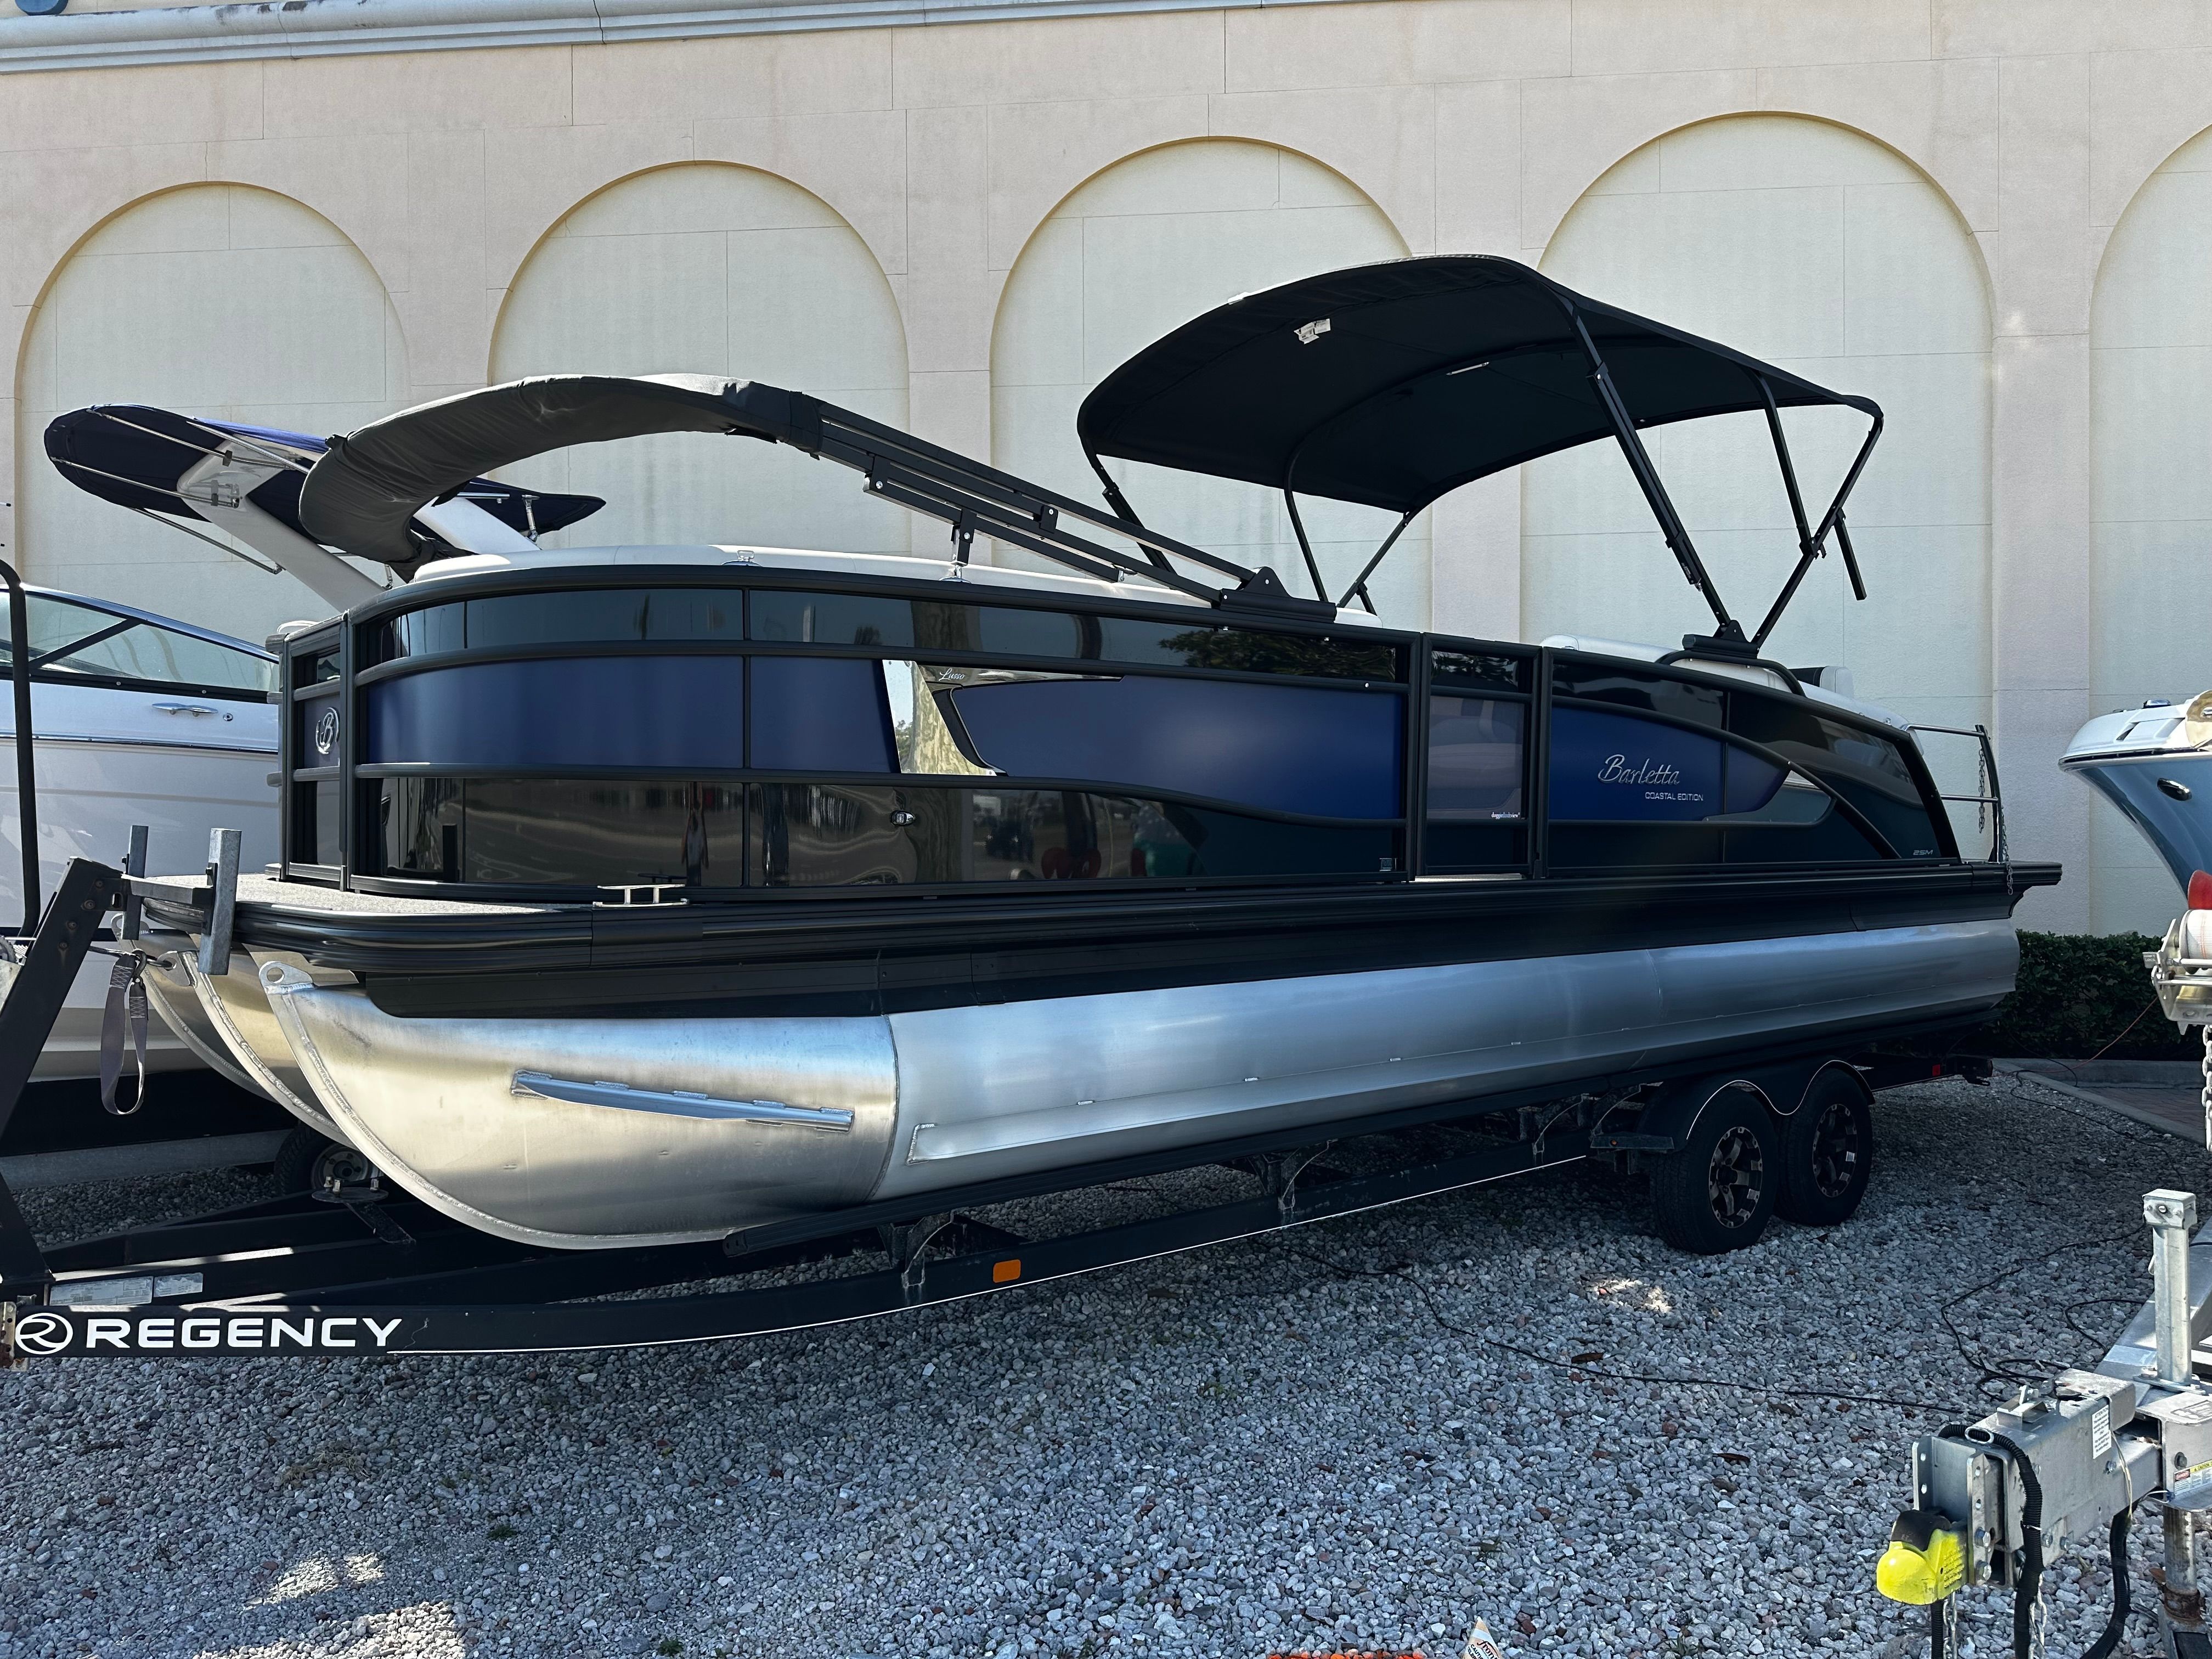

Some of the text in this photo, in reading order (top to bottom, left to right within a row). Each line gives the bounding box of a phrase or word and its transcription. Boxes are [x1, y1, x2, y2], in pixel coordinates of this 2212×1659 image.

[938, 667, 966, 681] Lusso
[1598, 754, 1680, 785] Barletta
[1645, 792, 1703, 801] COASTAL EDITION
[86, 1318, 403, 1348] REGENCY
